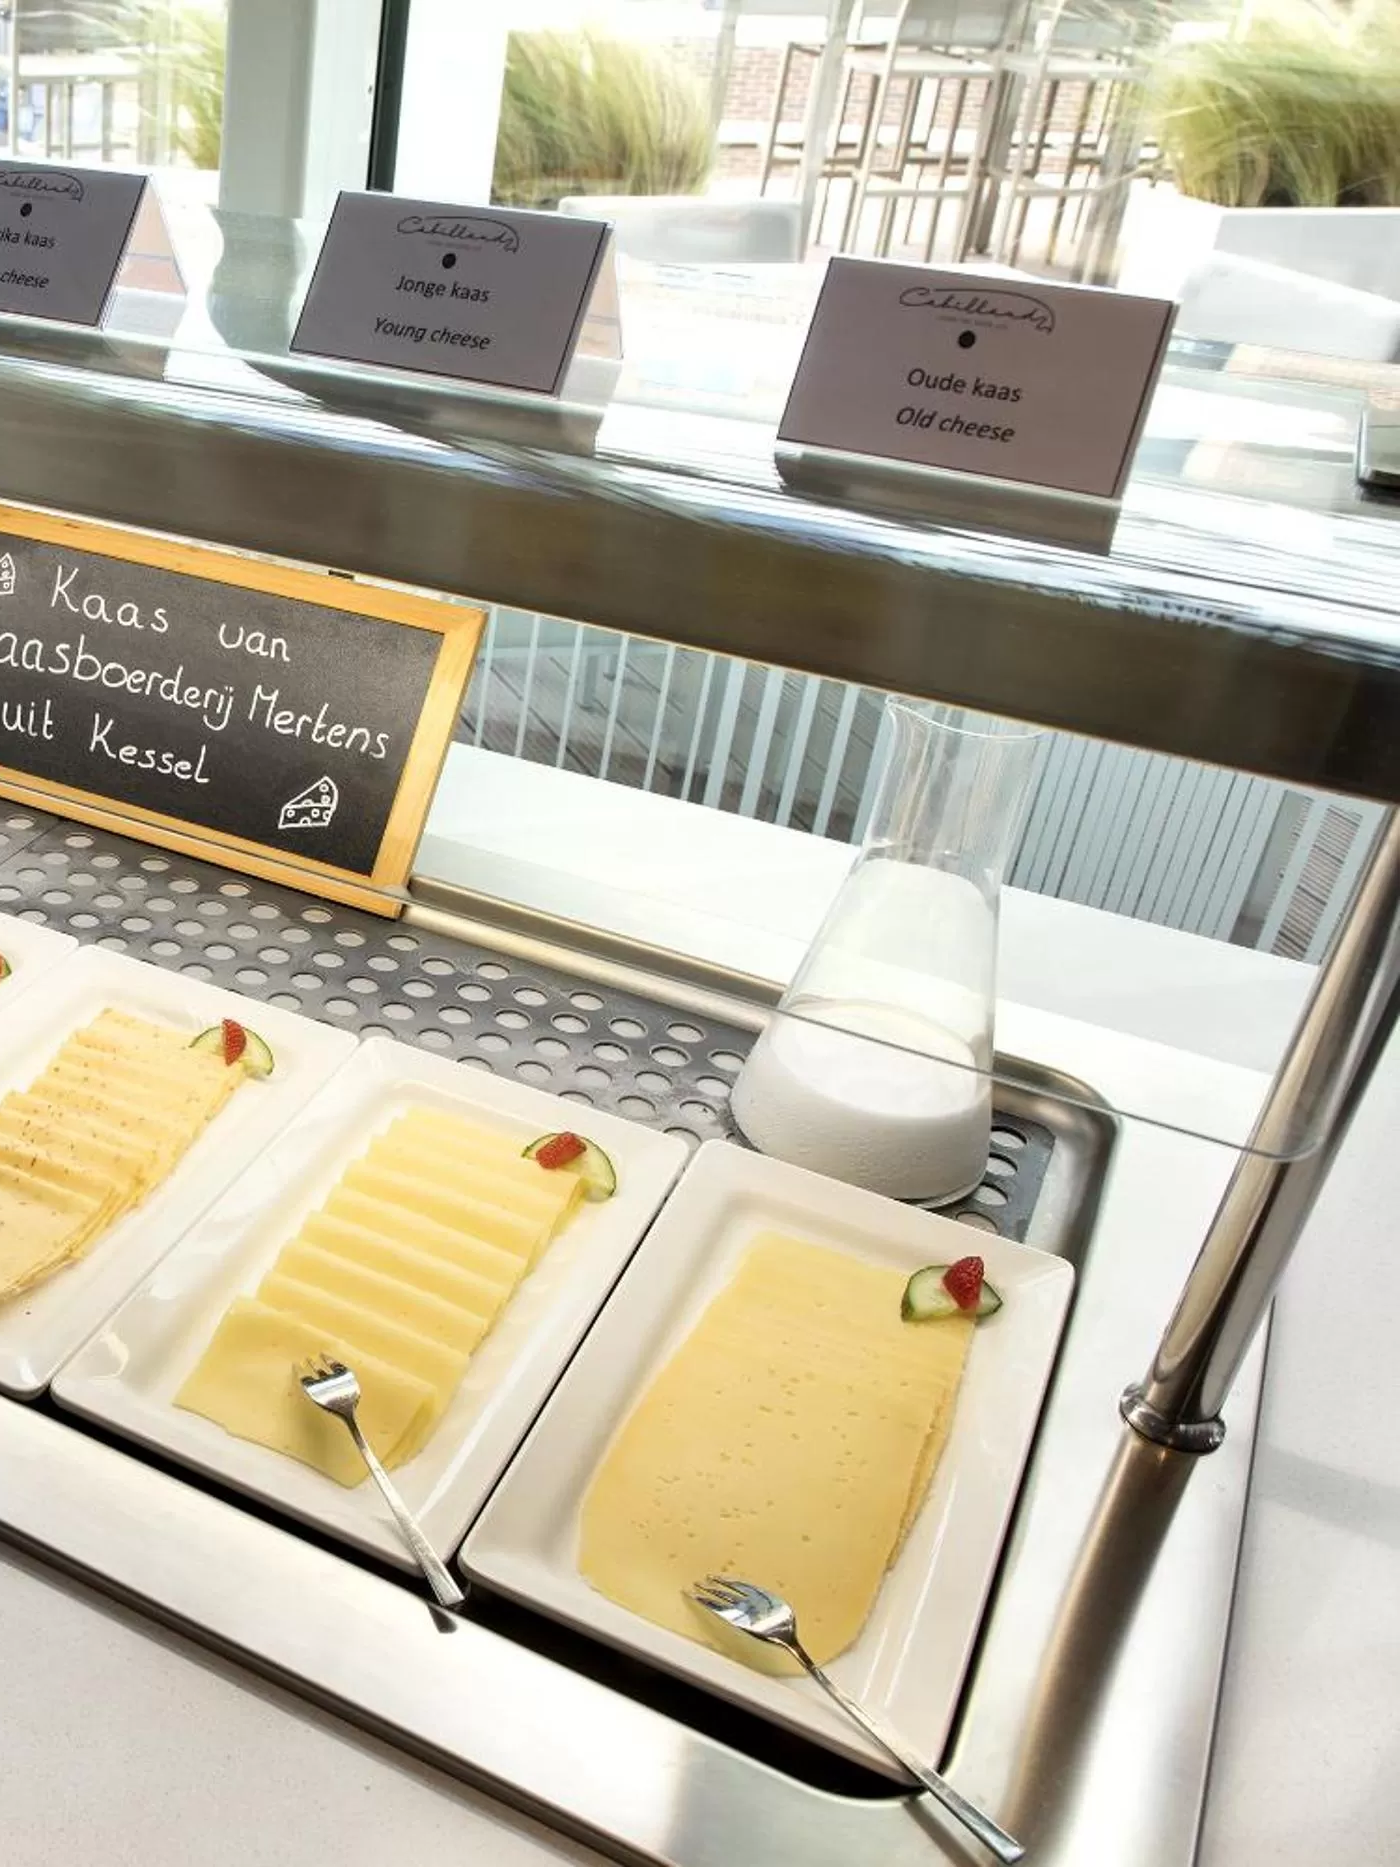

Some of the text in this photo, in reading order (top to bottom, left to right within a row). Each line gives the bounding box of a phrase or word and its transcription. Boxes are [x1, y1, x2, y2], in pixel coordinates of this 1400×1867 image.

[24, 230, 56, 249] kaas
[0, 268, 49, 290] cheese
[395, 275, 491, 303] Jonge kaas
[374, 316, 492, 351] Young cheese
[907, 367, 1024, 403] Oude kaas
[896, 406, 1016, 443] Old cheese
[49, 564, 292, 663] Kaas van
[247, 683, 392, 761] Mertens
[0, 699, 211, 785] uit Kessel
